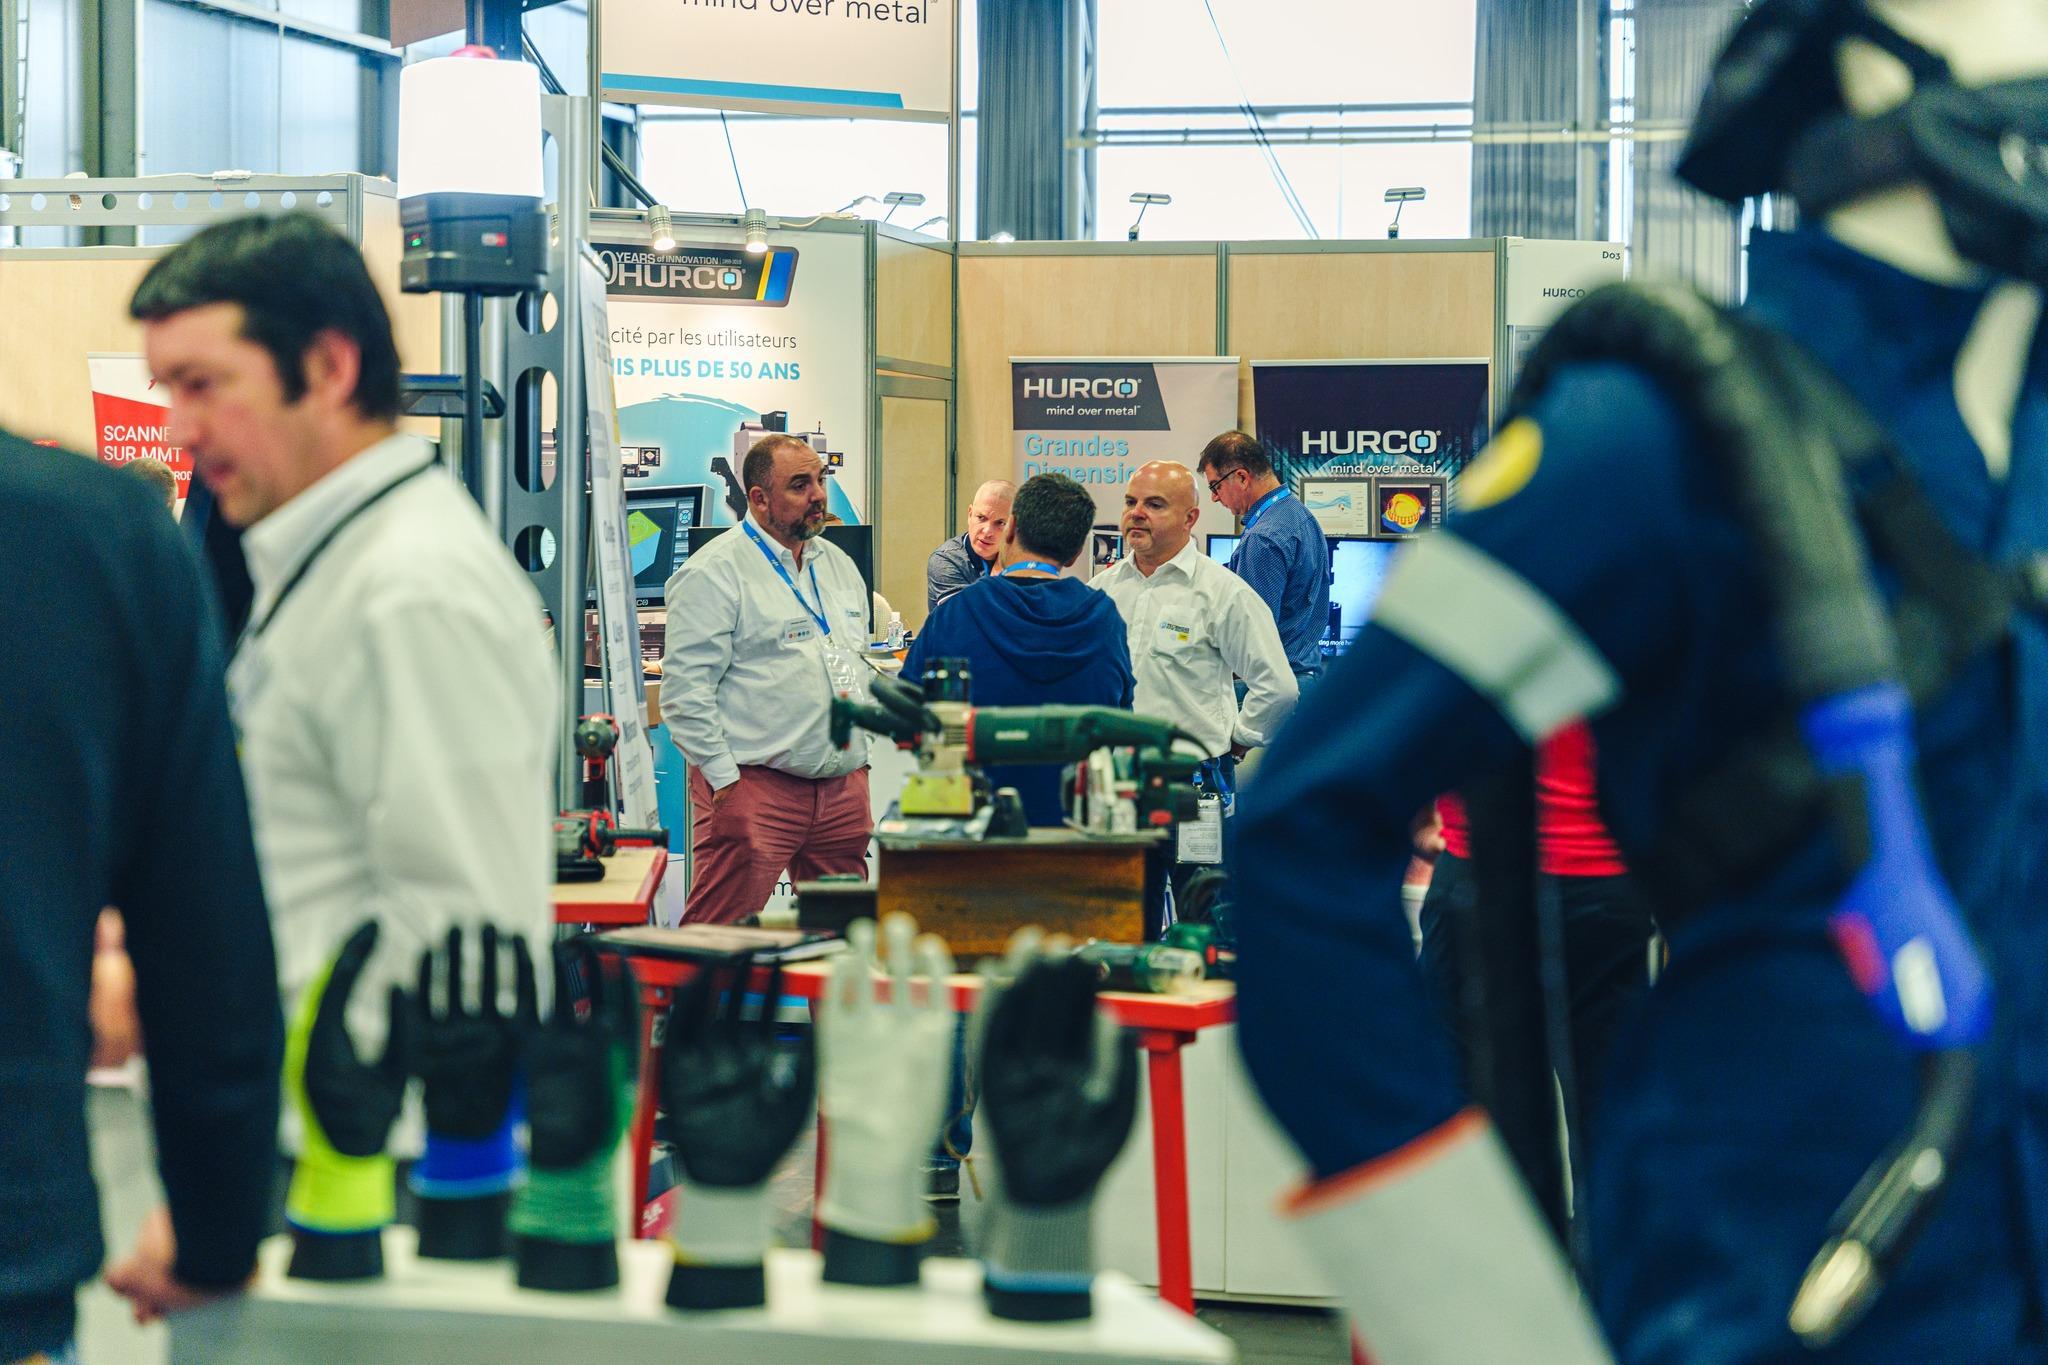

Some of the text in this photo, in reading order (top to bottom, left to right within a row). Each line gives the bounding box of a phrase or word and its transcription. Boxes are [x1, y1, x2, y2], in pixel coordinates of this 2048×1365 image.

[770, 0, 834, 16] over
[616, 251, 655, 264] YEARS
[665, 255, 719, 265] INNOVATION
[618, 264, 743, 290] HURCO
[1543, 288, 1585, 298] HURCO
[648, 331, 675, 348] par
[680, 328, 702, 345] les
[707, 330, 797, 348] utilisateurs
[640, 359, 691, 377] PLUS
[697, 360, 724, 378] DE
[729, 361, 753, 379] 50
[758, 362, 801, 380] ANS
[1024, 378, 1138, 399] HURCO
[1046, 405, 1137, 416] mind over metal
[1024, 434, 1129, 457] Grandes
[1302, 430, 1437, 455] HURCO
[103, 445, 183, 463] SUR MMT
[1330, 462, 1436, 474] mind over metal
